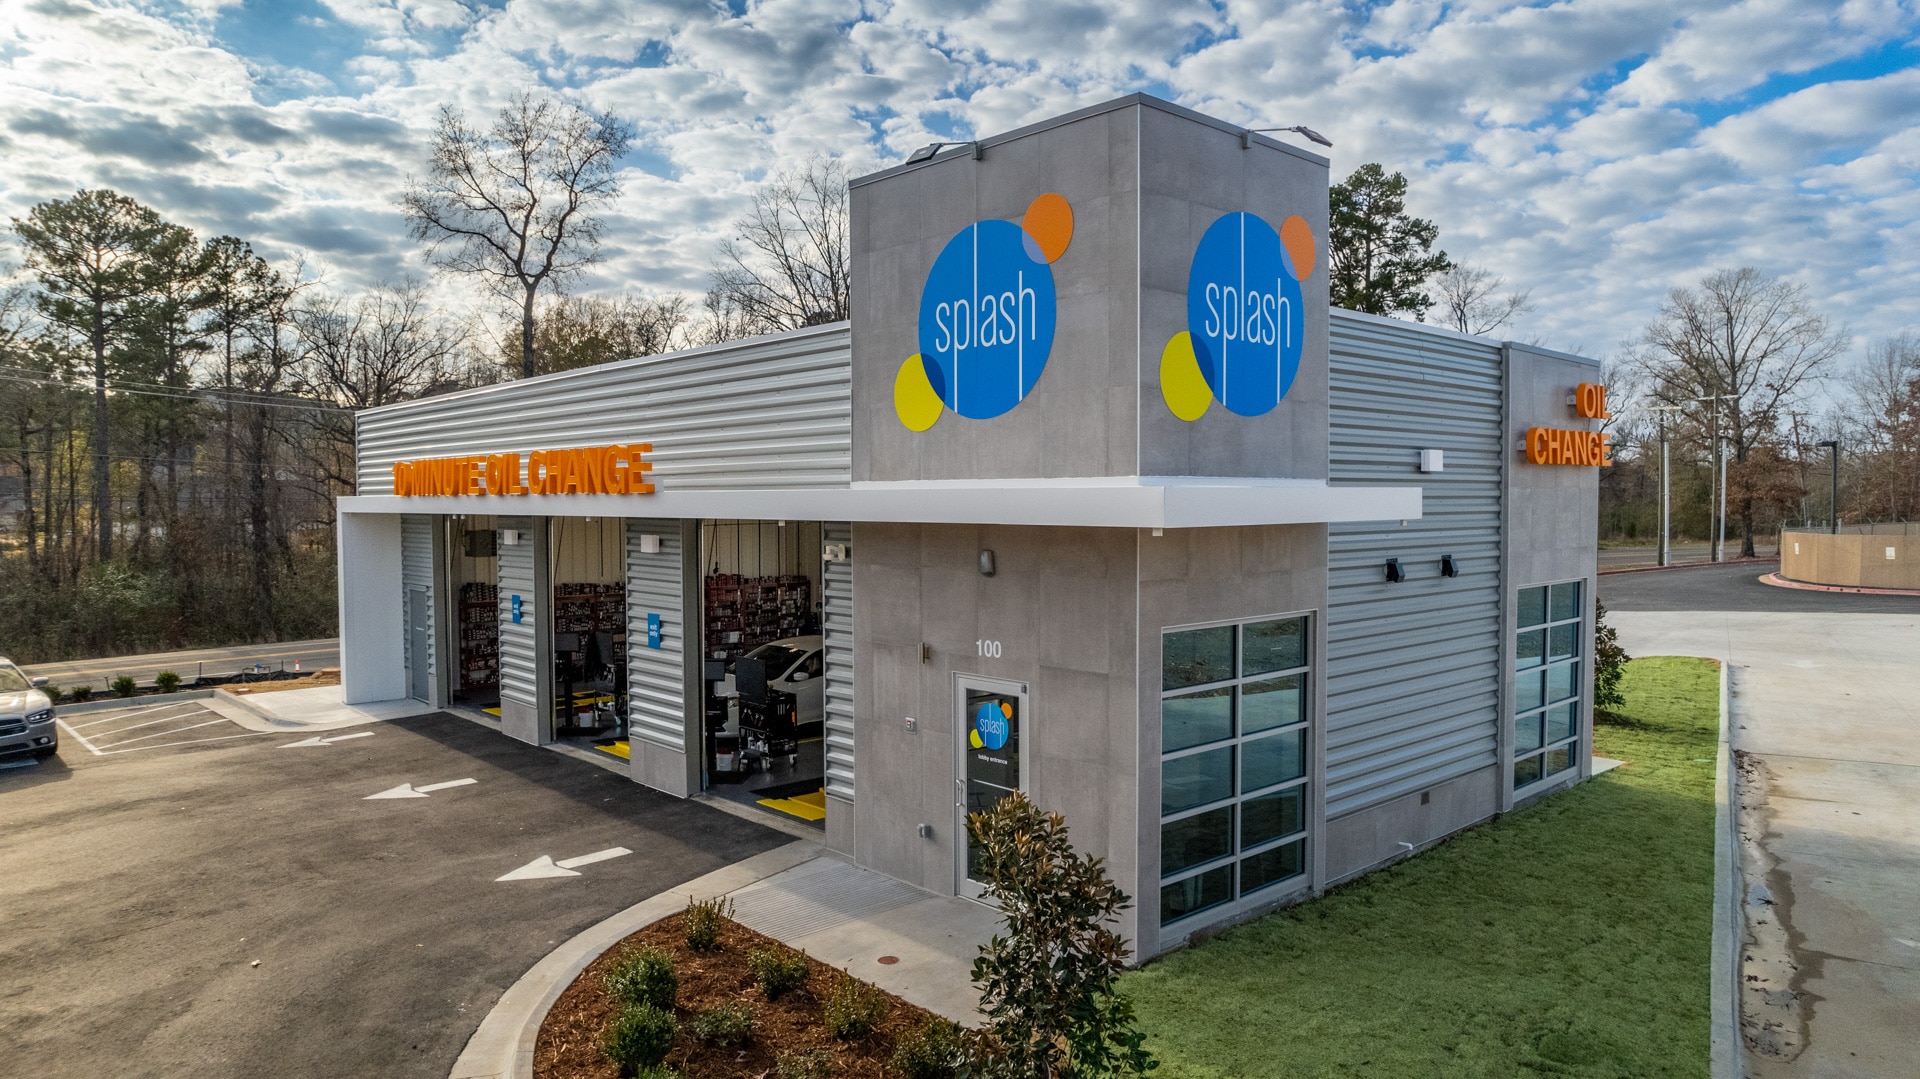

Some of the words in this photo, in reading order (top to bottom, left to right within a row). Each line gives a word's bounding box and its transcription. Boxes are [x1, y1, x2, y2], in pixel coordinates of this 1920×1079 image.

[1576, 383, 1611, 419] OIL
[1526, 427, 1612, 467] CHANGE
[392, 462, 412, 496] 10
[411, 456, 486, 496] MINUTE
[486, 453, 528, 496] OIL
[528, 443, 655, 495] CHANGE
[976, 639, 1001, 658] 100
